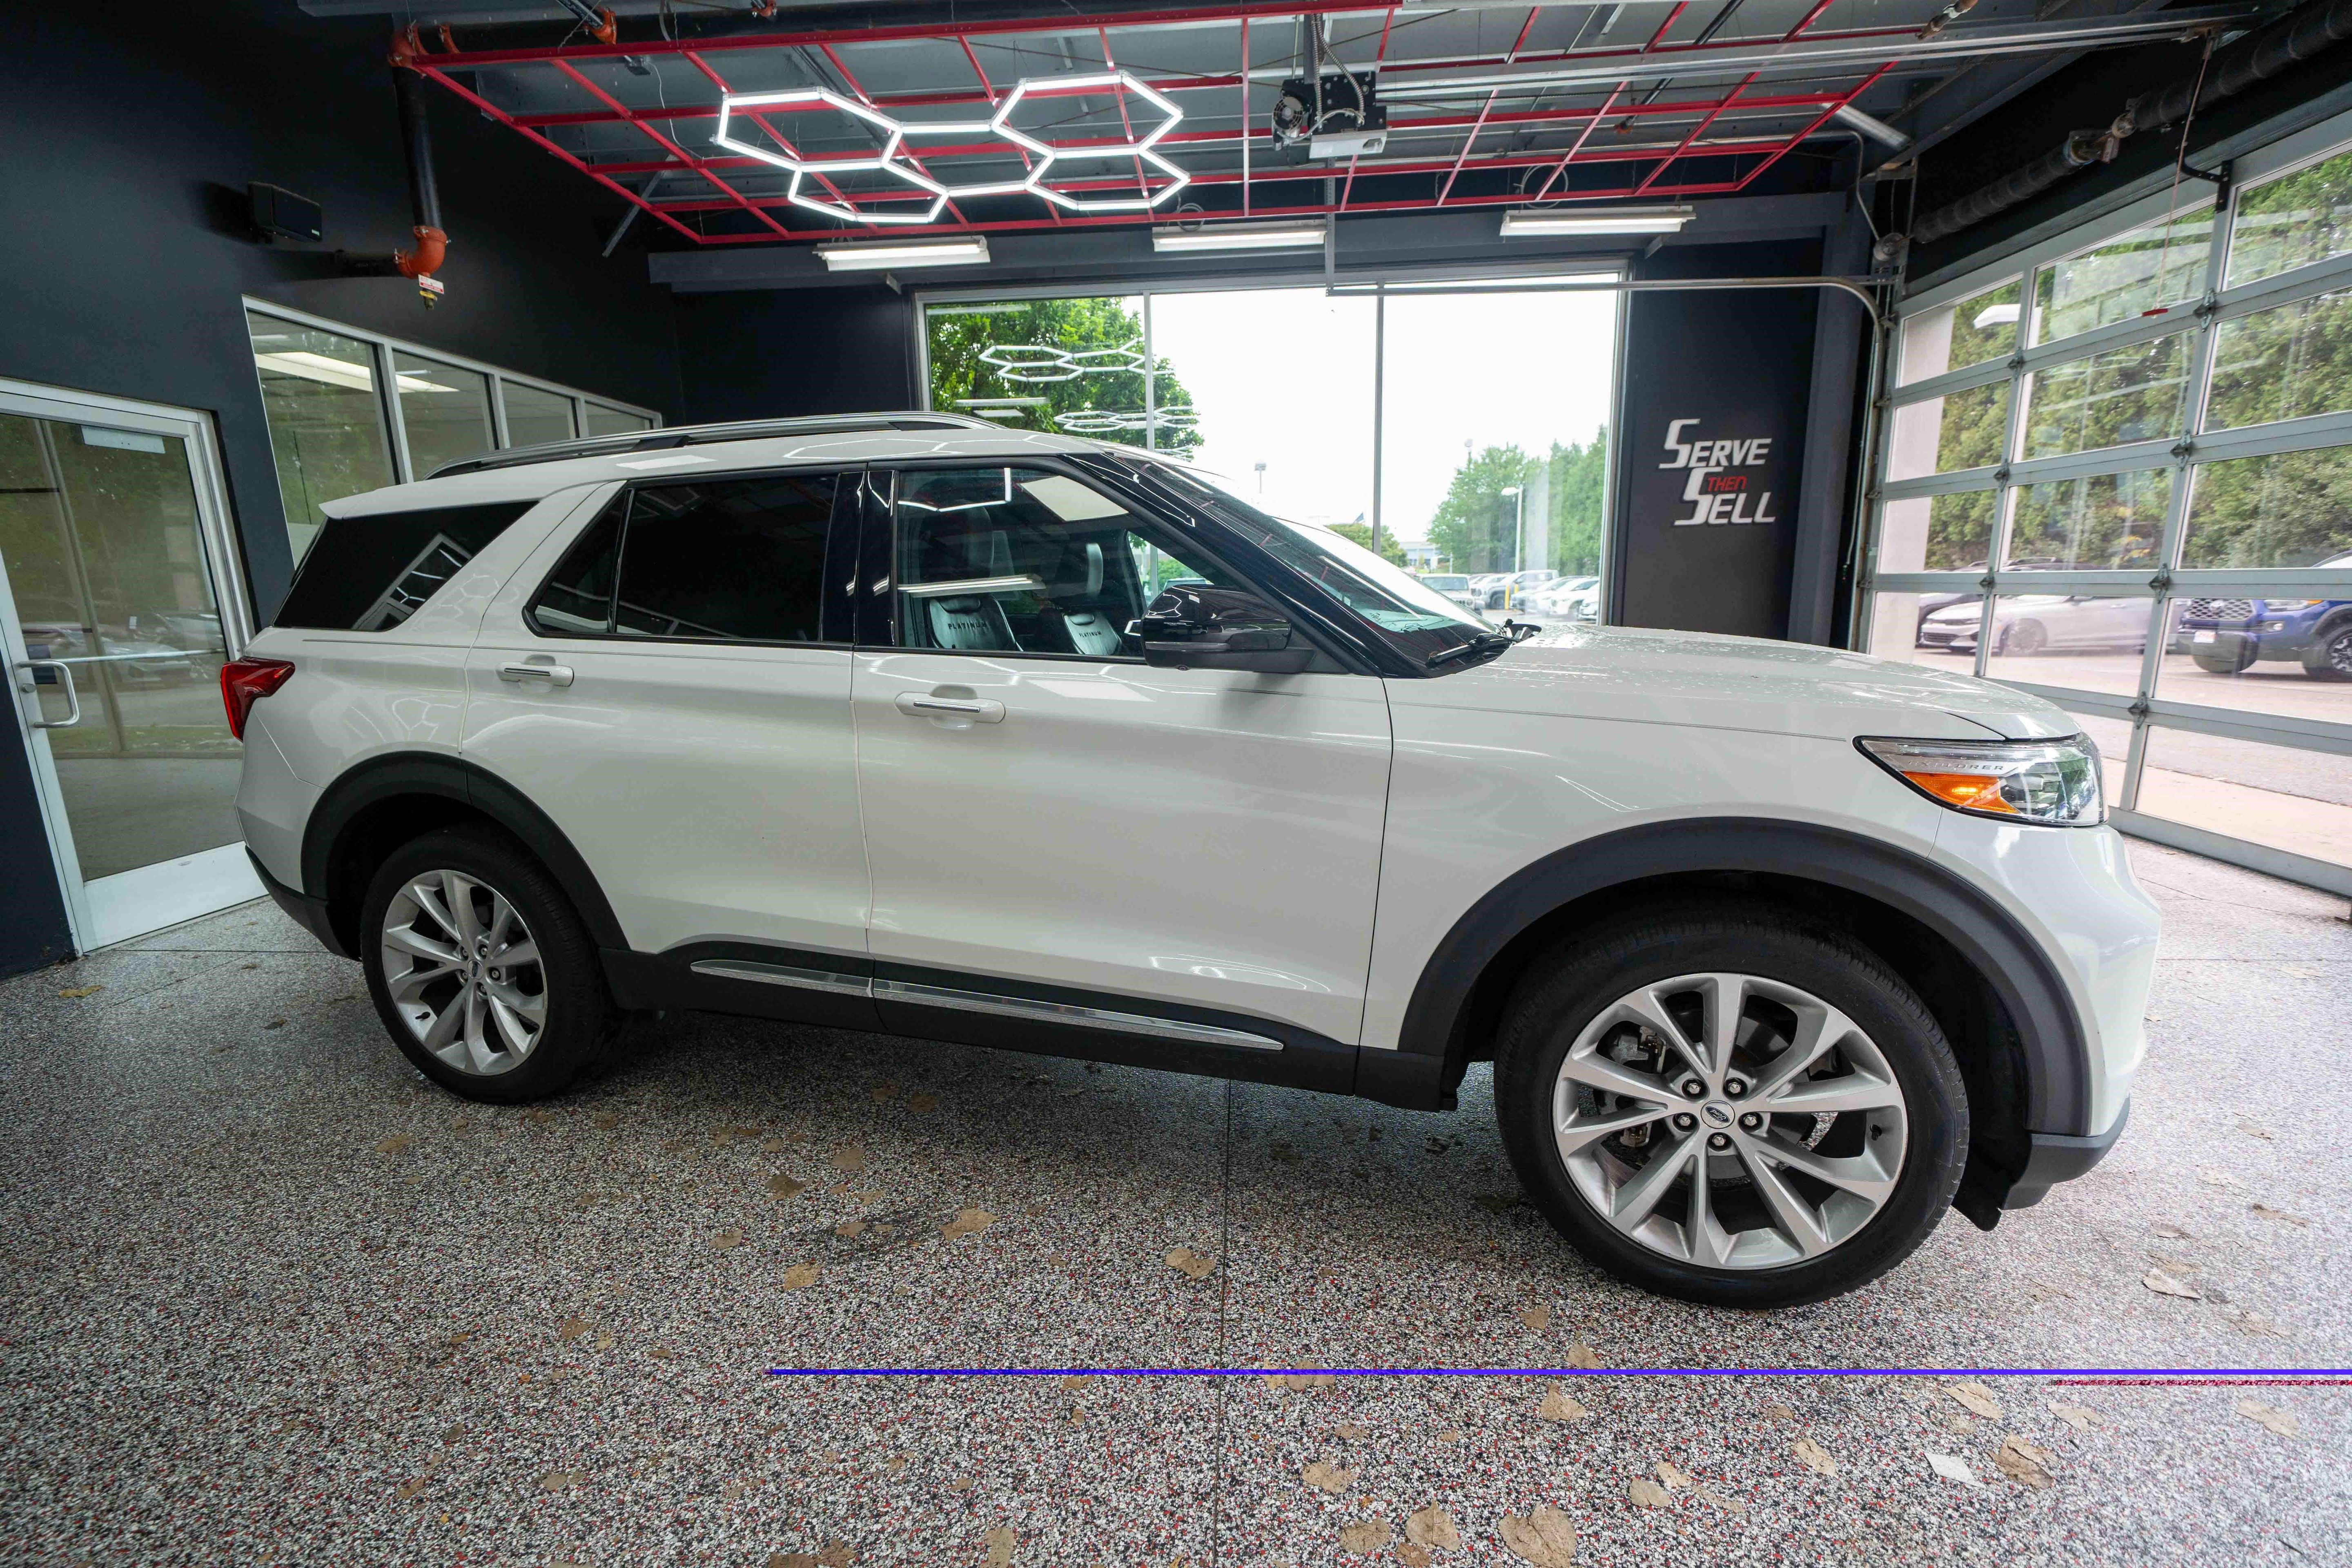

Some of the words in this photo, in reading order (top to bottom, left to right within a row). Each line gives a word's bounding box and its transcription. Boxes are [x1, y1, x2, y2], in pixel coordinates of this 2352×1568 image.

[1658, 418, 1773, 469] SERVE
[1674, 466, 1776, 526] SELL
[1708, 476, 1748, 492] THEN
[1709, 1109, 1727, 1121] Ford
